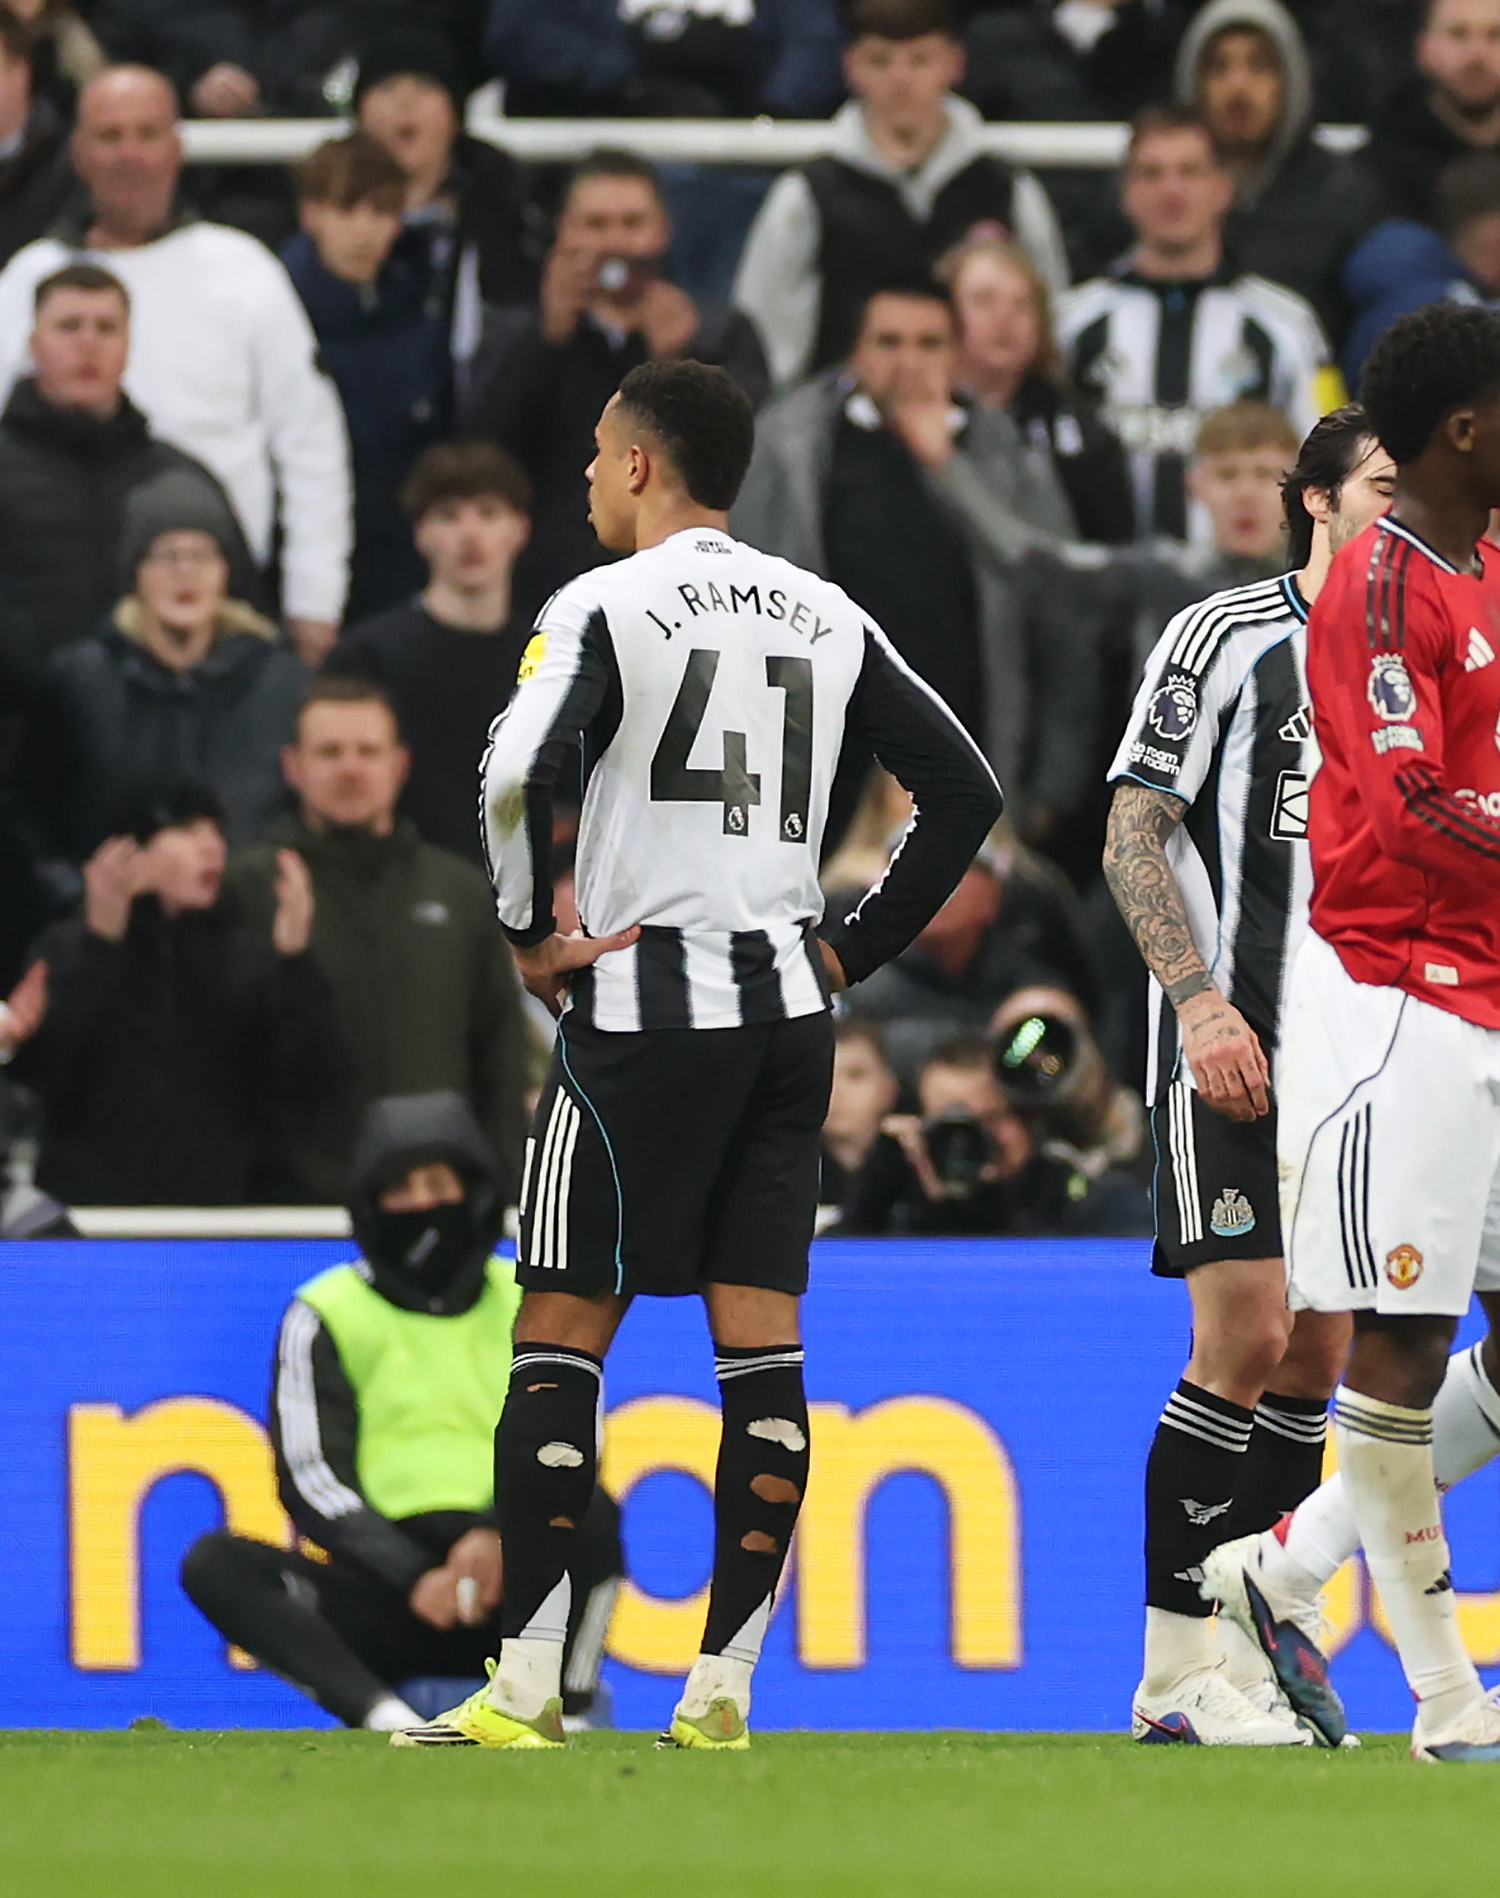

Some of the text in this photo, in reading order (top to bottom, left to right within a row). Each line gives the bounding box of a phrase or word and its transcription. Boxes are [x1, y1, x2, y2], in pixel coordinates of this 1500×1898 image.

[645, 581, 833, 645] J. RAMSEY
[650, 648, 814, 844] 41
[1142, 755, 1181, 776] racism
[1145, 745, 1179, 765] room
